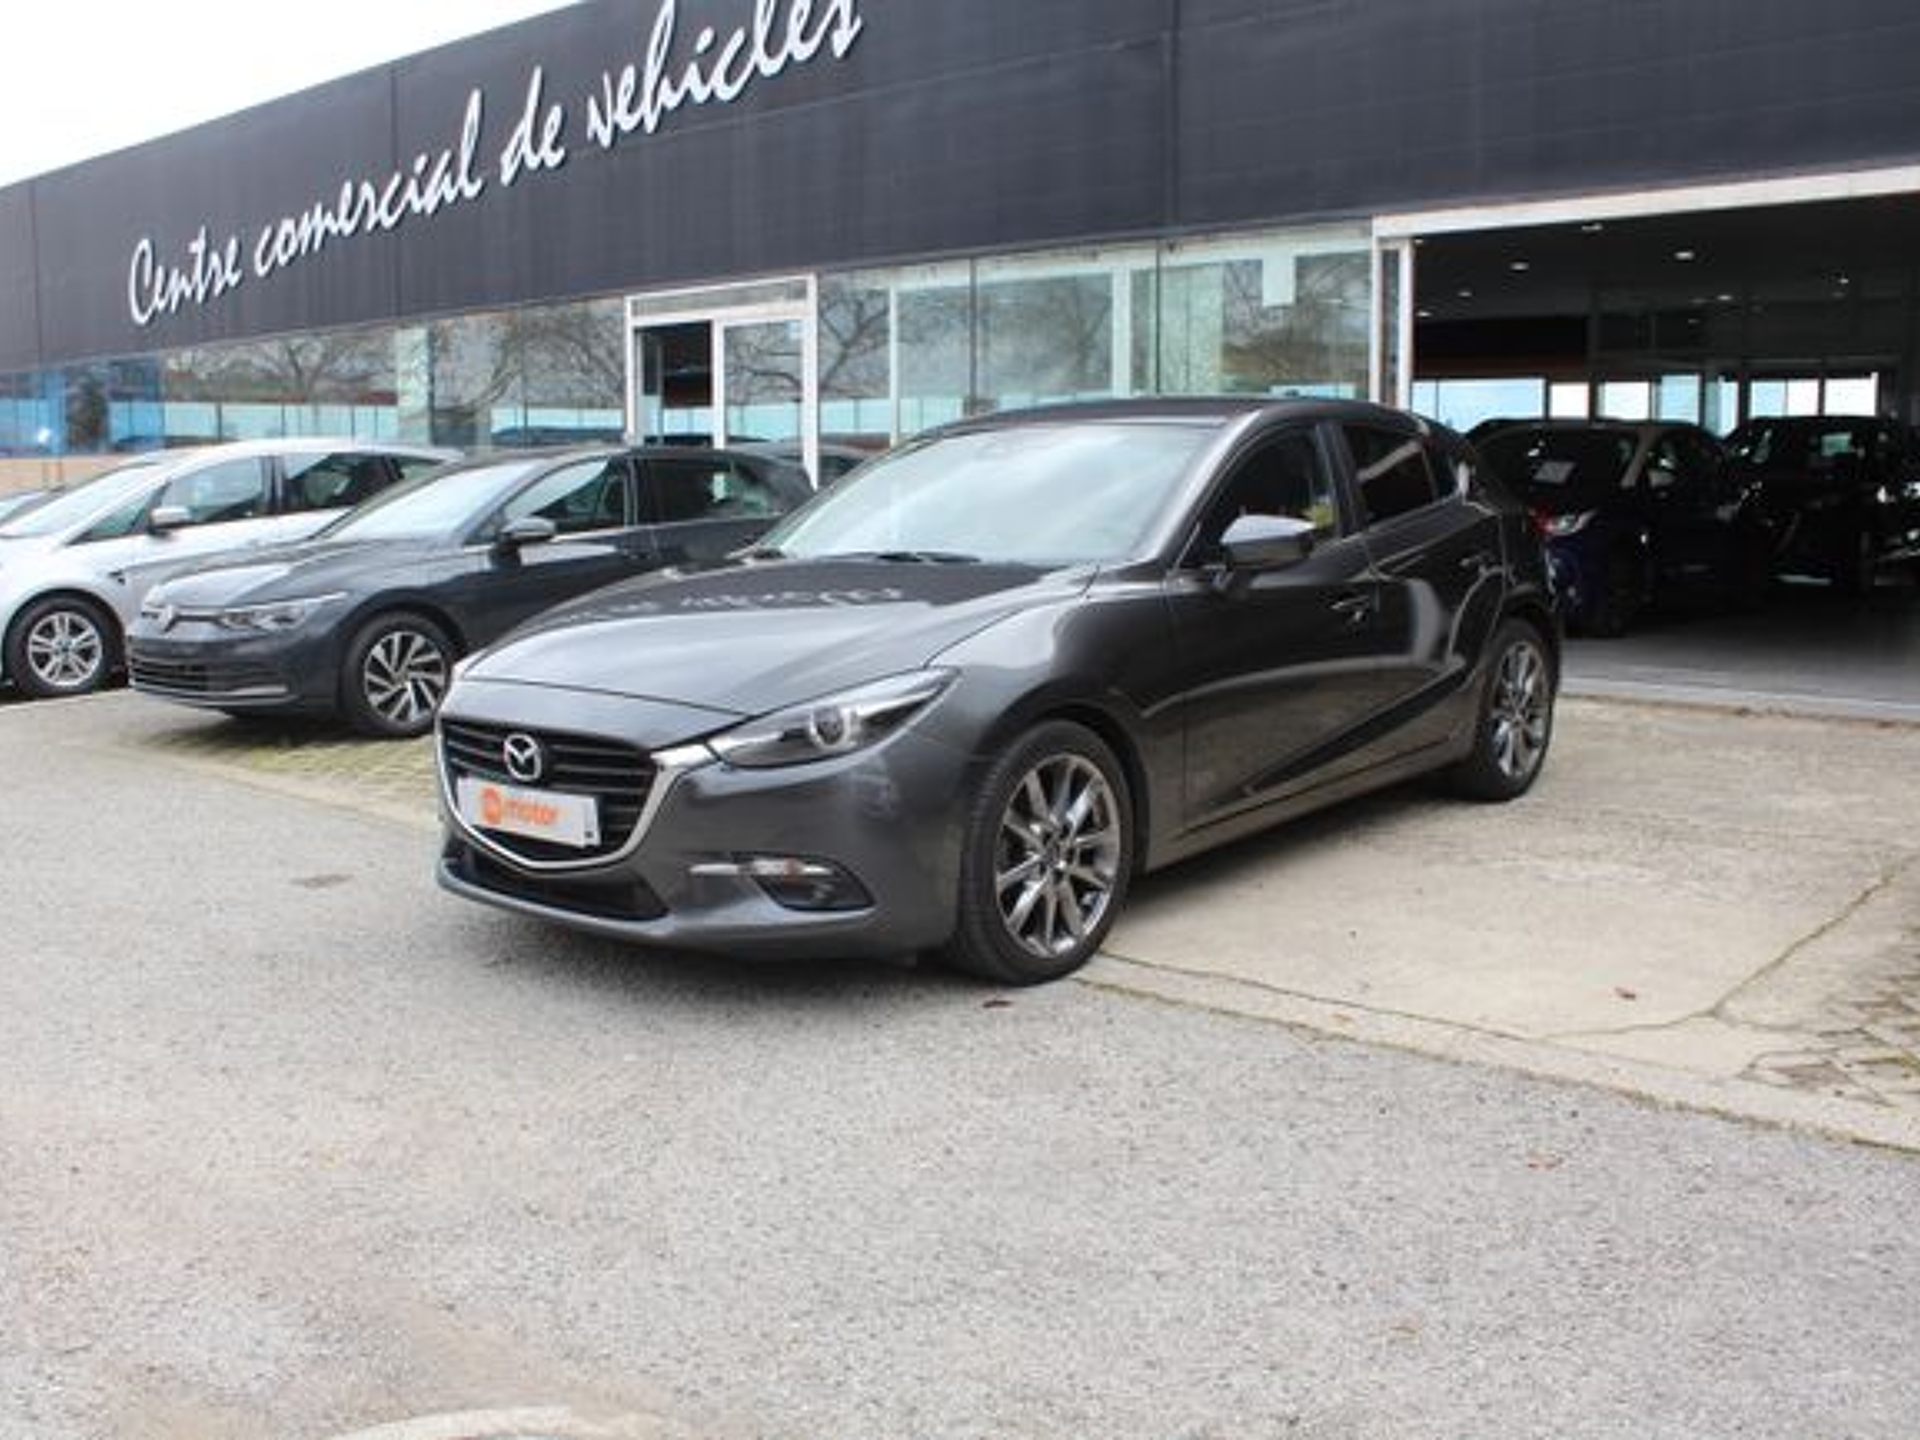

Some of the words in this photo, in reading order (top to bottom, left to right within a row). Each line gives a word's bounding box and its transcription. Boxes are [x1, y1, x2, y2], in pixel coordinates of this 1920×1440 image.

[128, 226, 241, 324] Centre
[254, 89, 482, 276] comercial
[500, 66, 564, 186] de
[587, 0, 861, 147] vehicles
